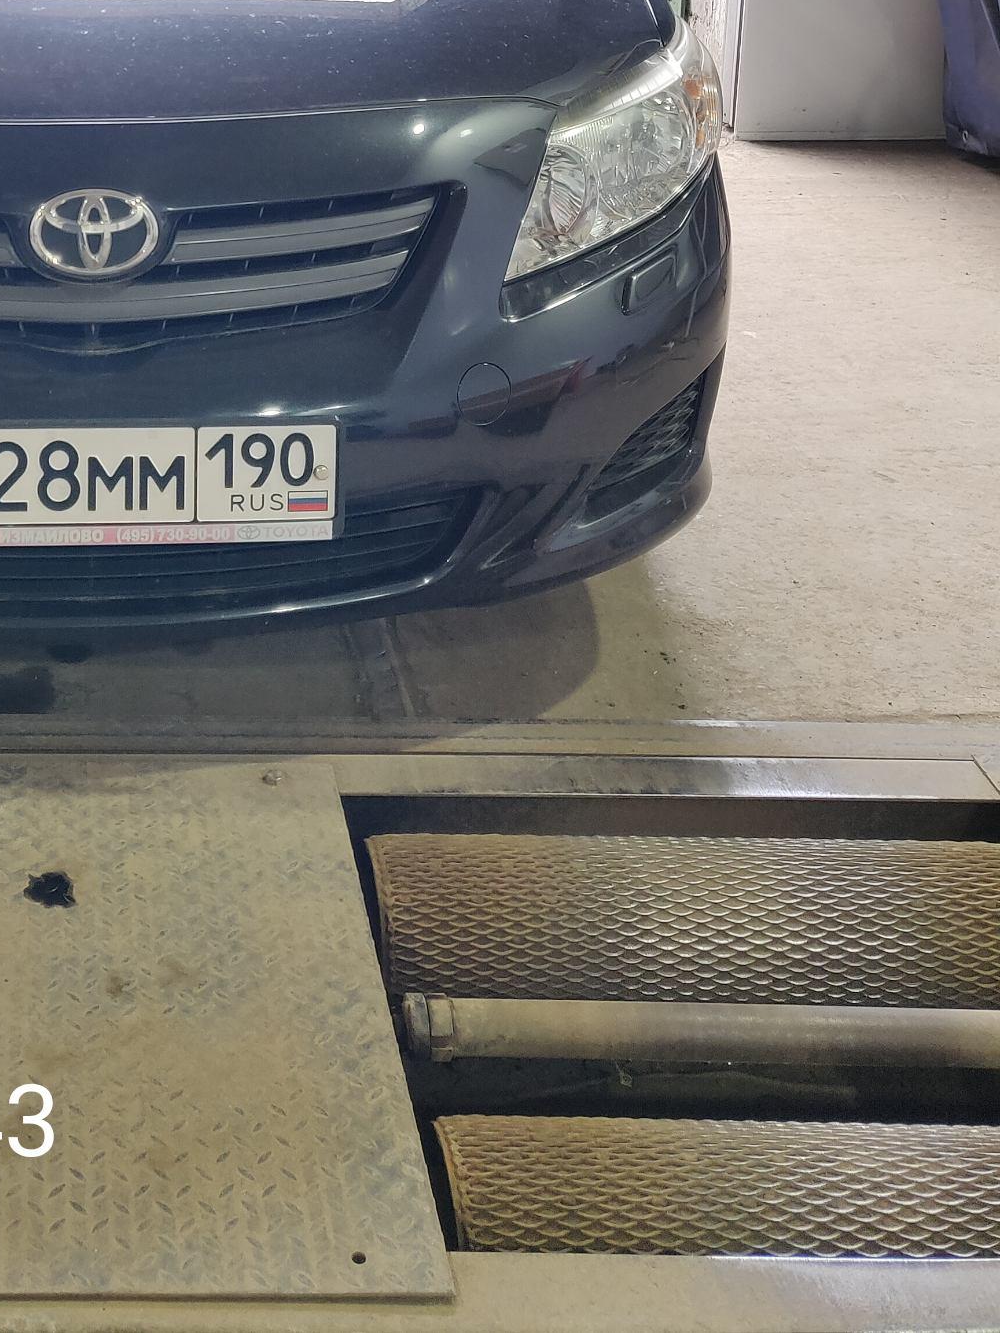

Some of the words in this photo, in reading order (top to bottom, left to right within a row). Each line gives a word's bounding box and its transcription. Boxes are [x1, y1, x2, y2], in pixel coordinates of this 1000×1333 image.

[205, 433, 314, 489] 190
[230, 493, 284, 512] RUS
[117, 526, 154, 543] (495)
[158, 526, 231, 542] 730-90-00
[264, 525, 329, 539] TOYOTA
